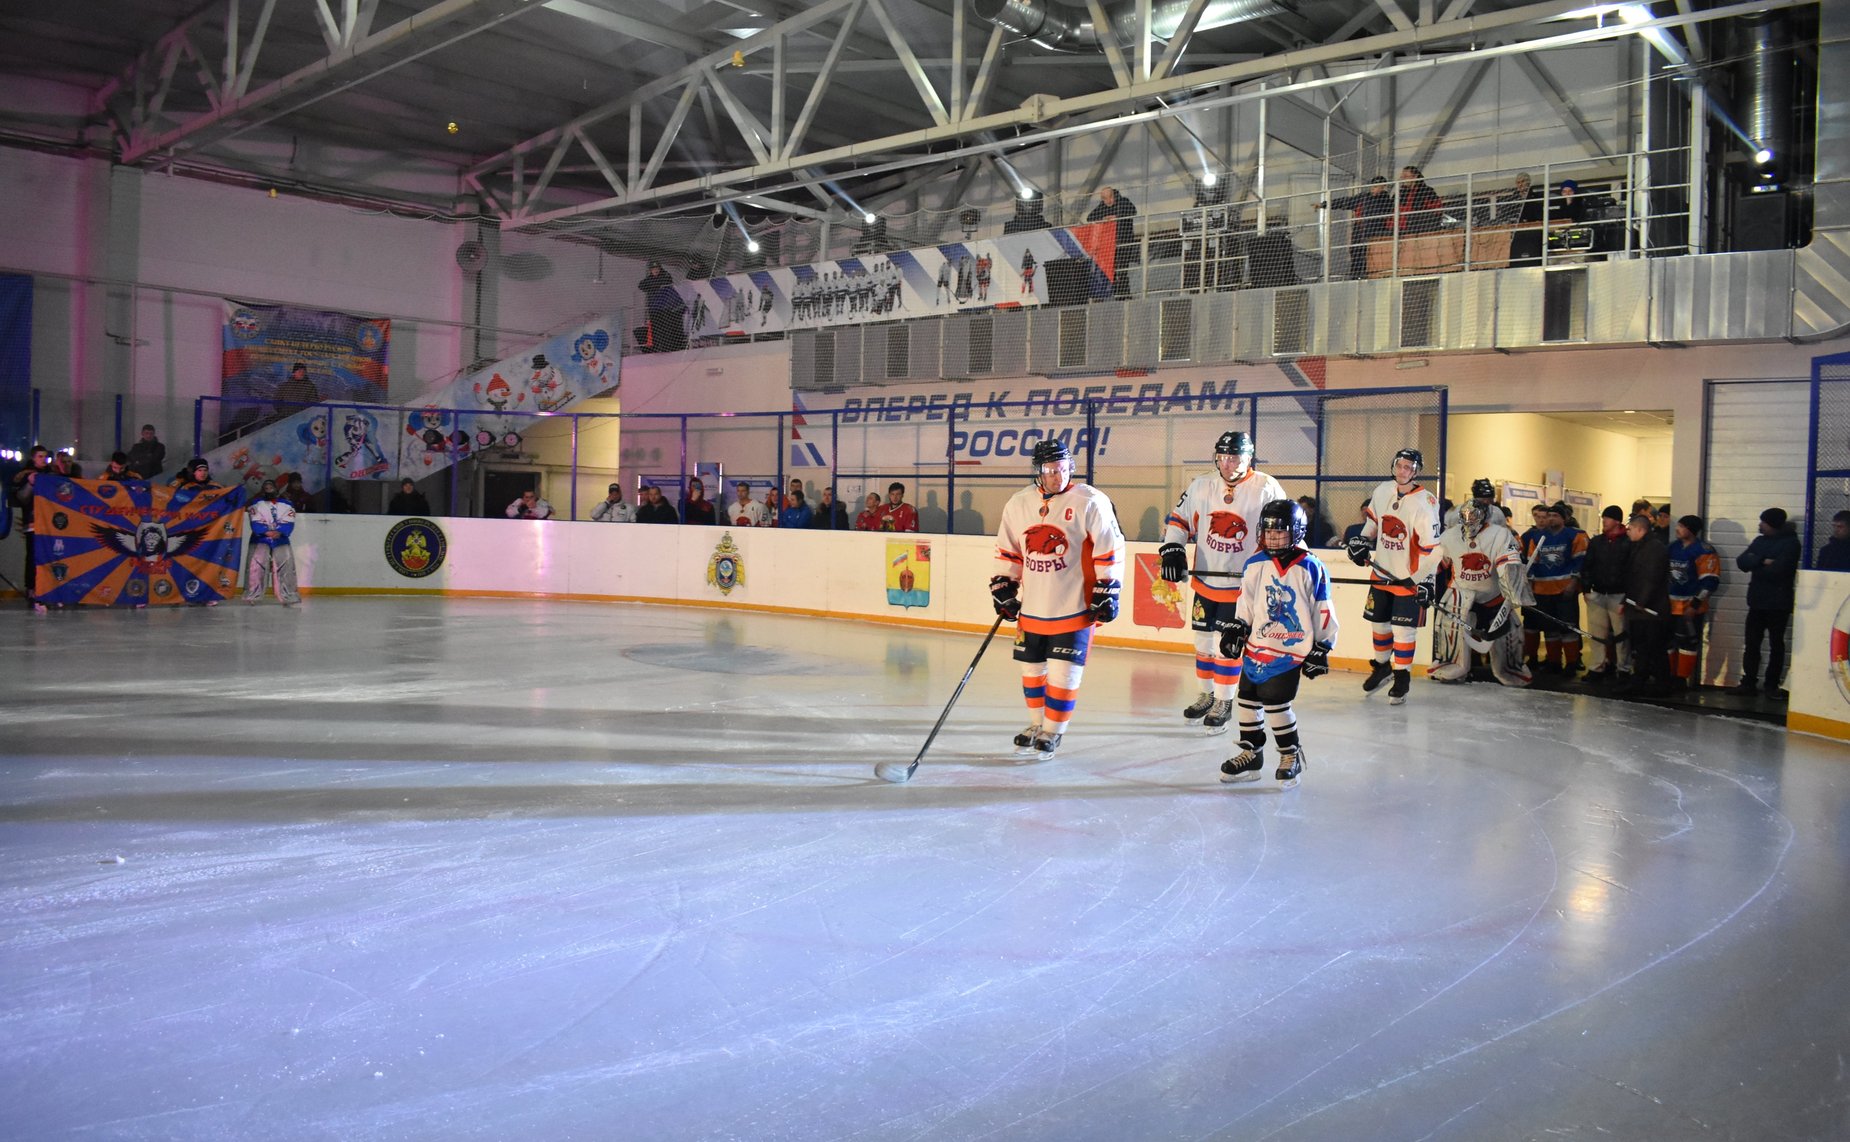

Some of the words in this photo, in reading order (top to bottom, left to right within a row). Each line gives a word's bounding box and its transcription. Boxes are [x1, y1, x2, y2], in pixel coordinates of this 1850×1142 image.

[842, 392, 973, 423] ВПЕРЕД
[985, 391, 1011, 418] К
[1023, 380, 1245, 417] ПОБЕДАМ,
[946, 426, 1111, 460] РОССИЯ!
[1206, 534, 1244, 553] БОБРЫ
[1025, 556, 1068, 573] БОБРЫ
[1460, 571, 1491, 581] БОБРЫ
[1320, 609, 1331, 631] 7
[1052, 646, 1083, 656] CCM
